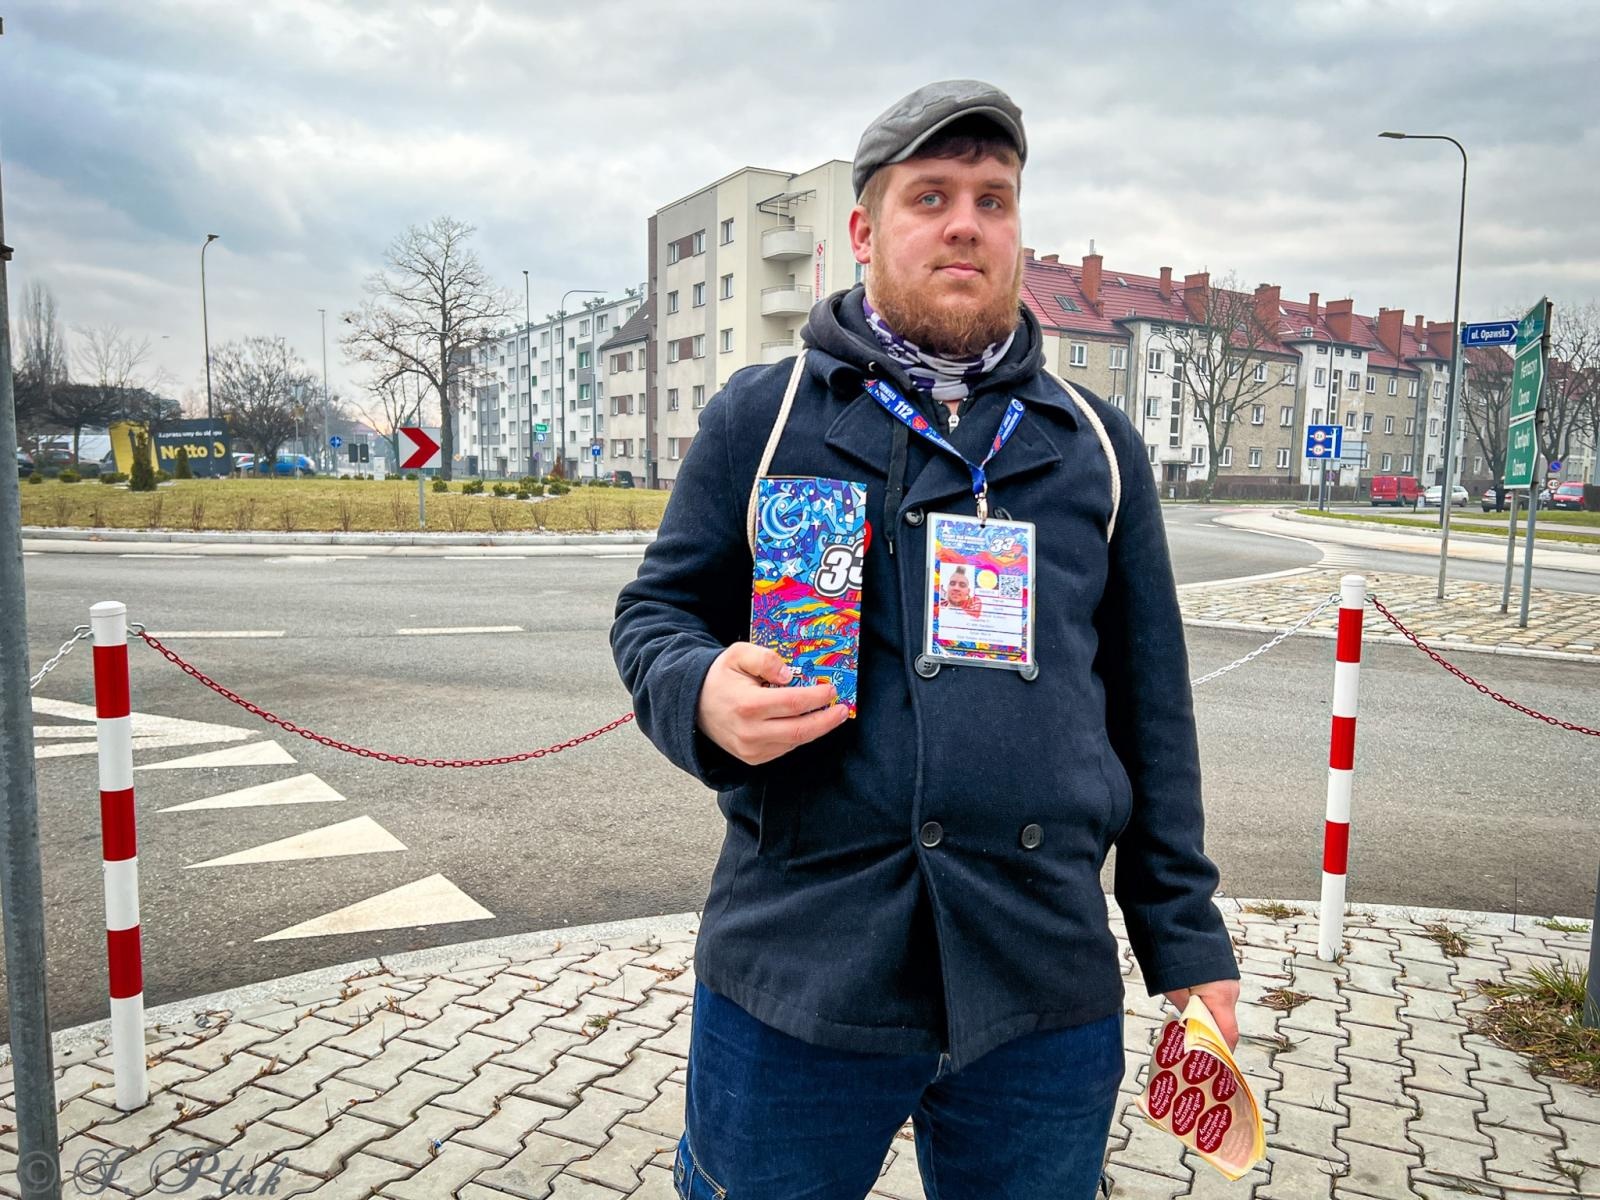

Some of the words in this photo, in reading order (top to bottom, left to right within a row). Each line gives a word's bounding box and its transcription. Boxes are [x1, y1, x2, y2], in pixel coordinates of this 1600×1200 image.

[1471, 330, 1479, 339] ul.
[1481, 327, 1510, 341] Opawska
[894, 400, 914, 419] 112
